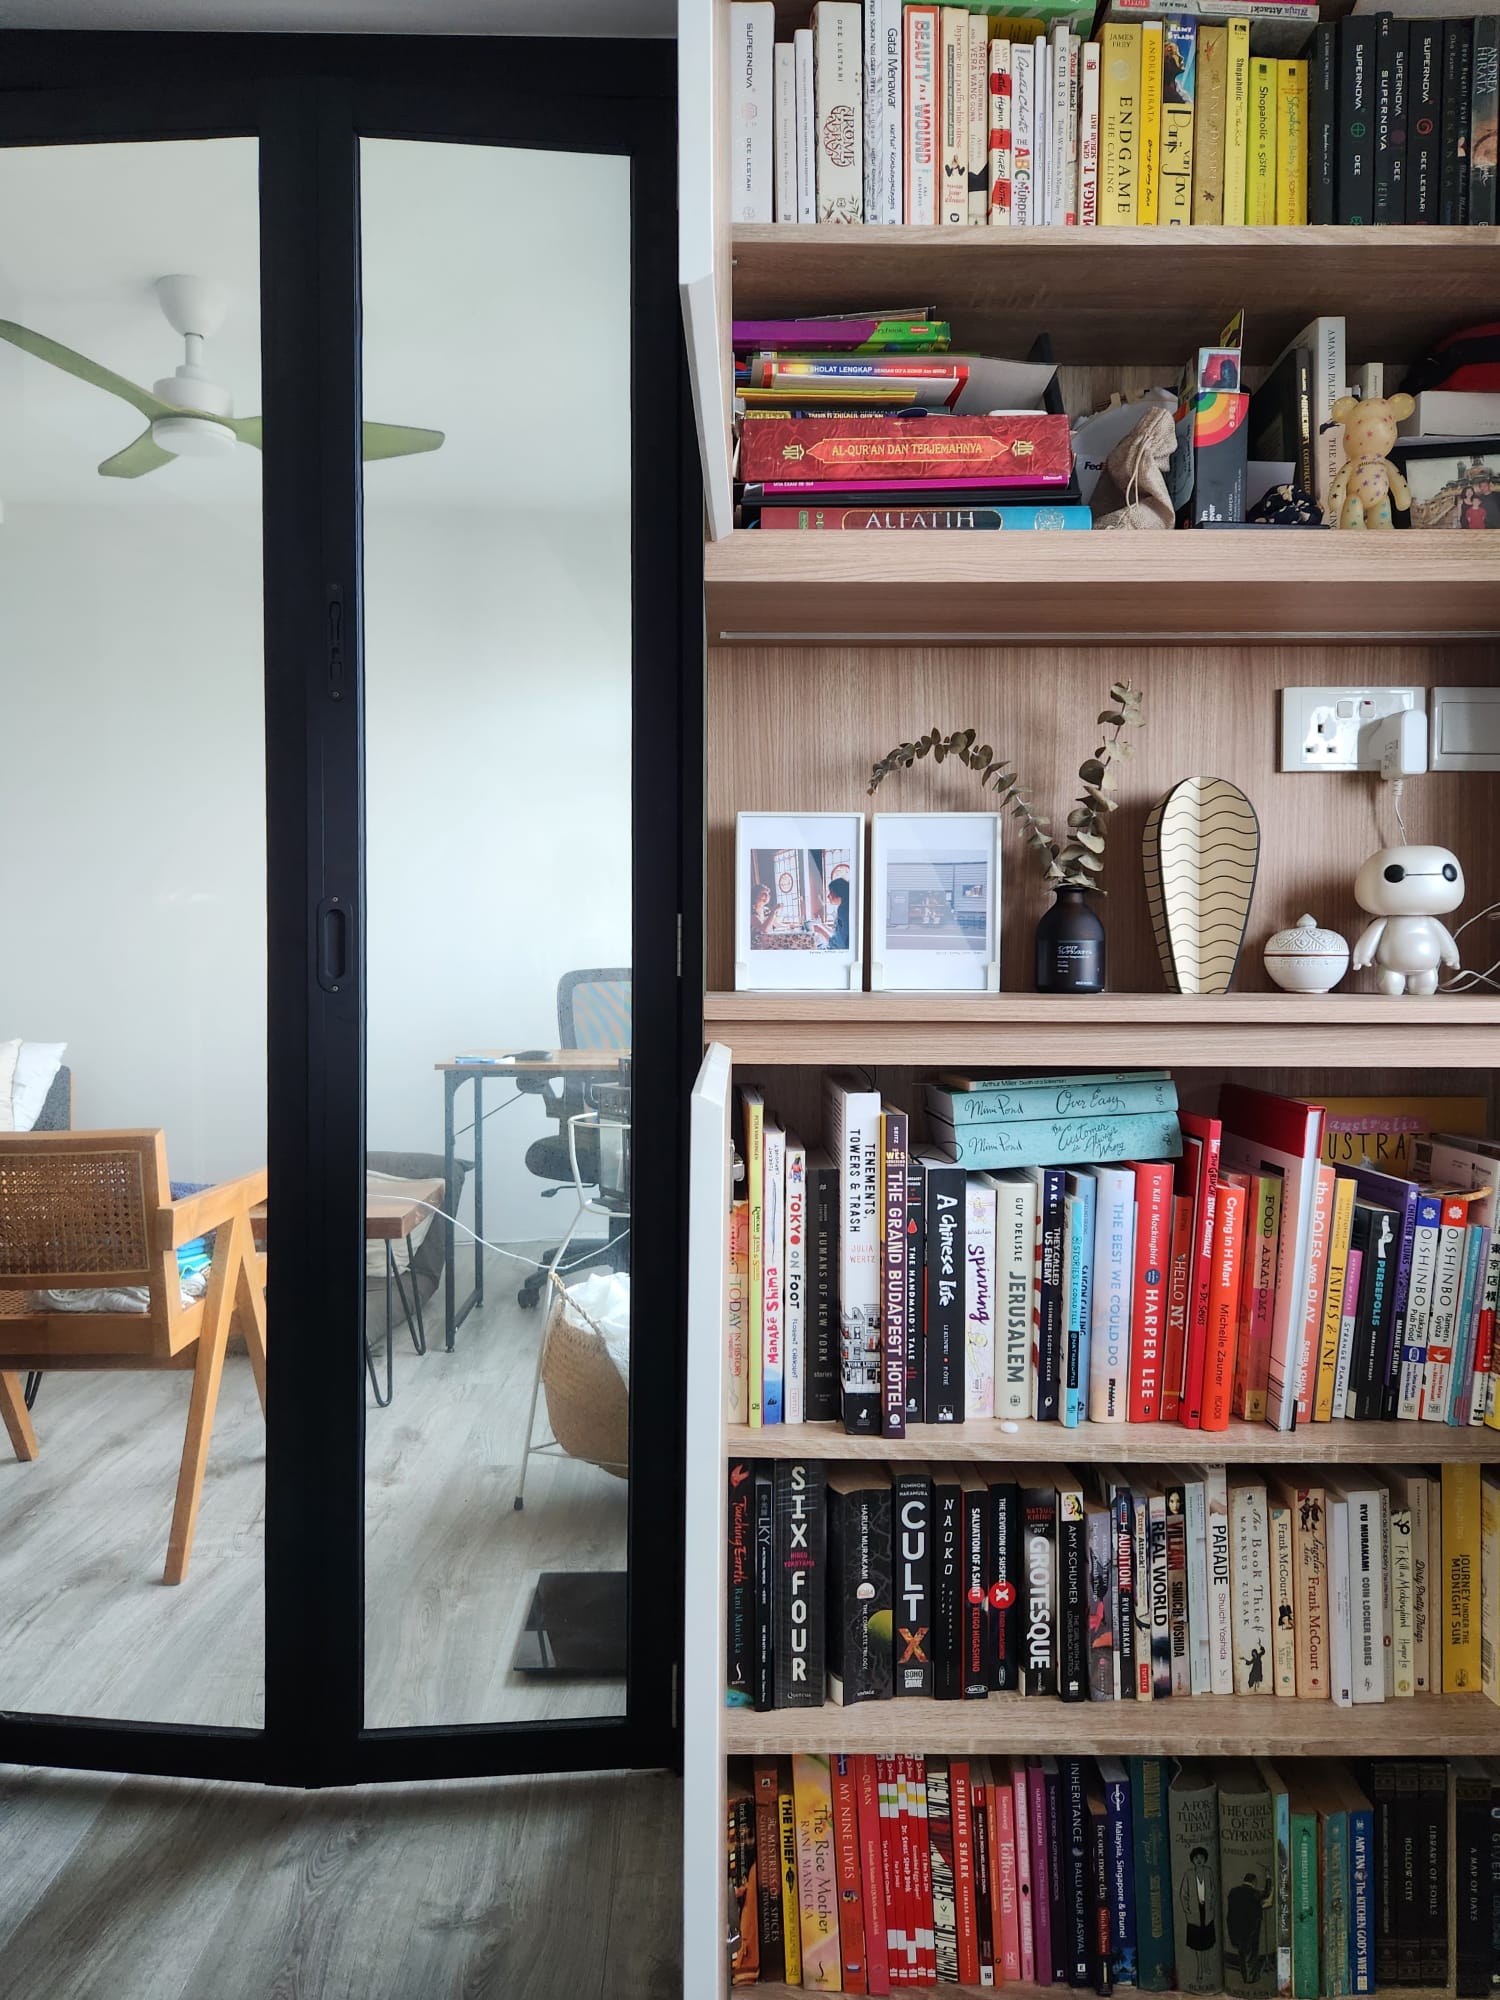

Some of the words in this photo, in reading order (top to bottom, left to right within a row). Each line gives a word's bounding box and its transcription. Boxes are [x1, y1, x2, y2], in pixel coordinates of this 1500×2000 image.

[888, 28, 897, 56] Gatal
[915, 20, 930, 81] BEAUTY
[888, 59, 897, 108] Menawar
[1058, 48, 1066, 107] semasa
[1395, 52, 1404, 116] SUPERNOVA
[1422, 38, 1431, 102] SUPERNOVA
[1477, 47, 1487, 94] HIRATA
[1487, 49, 1497, 93] ANDREA
[1380, 70, 1388, 150] SUPERNOVA
[915, 103, 931, 163] WOUND
[1118, 96, 1132, 212] ENDGAME
[832, 445, 884, 457] AL-QUR'AN
[887, 444, 908, 455] DAN
[911, 444, 982, 455] TERJEMAHNYA
[866, 511, 975, 529] ALFATIH
[850, 1129, 860, 1177] TOWERS
[864, 1144, 875, 1219] TENEMENTS,
[888, 1172, 902, 1201] THE
[1050, 1177, 1058, 1213] TAKEI
[1151, 1189, 1161, 1202] Kill
[1153, 1175, 1162, 1184] To
[790, 1194, 801, 1245] TOKYO
[850, 1195, 860, 1232] TRASH
[937, 1195, 958, 1210] A
[1014, 1198, 1023, 1218] GUY
[1113, 1202, 1123, 1231] THE
[1224, 1197, 1237, 1233] Crying
[1263, 1196, 1275, 1238] FOOD
[888, 1208, 902, 1263] GRAND
[940, 1215, 957, 1274] Chinese
[1014, 1224, 1023, 1262] DELISLE
[1045, 1232, 1052, 1243] US
[1053, 1227, 1061, 1247] THEY
[1112, 1235, 1122, 1264] BEST
[1148, 1214, 1160, 1264] Mockingbird
[1224, 1249, 1233, 1257] H
[1225, 1236, 1235, 1245] in
[790, 1251, 800, 1269] ON
[819, 1232, 827, 1277] HUMANS
[908, 1248, 916, 1265] THE
[1044, 1246, 1052, 1284] ENEMY
[790, 1274, 800, 1309] FOOT
[819, 1284, 827, 1297] OF
[968, 1244, 990, 1325] Spinning
[1111, 1271, 1121, 1289] WE
[1222, 1261, 1232, 1286] Mart
[1258, 1246, 1272, 1320] ANATOMY
[908, 1271, 916, 1333] HANDMAID'S
[939, 1280, 957, 1308] Life
[1373, 1260, 1386, 1325] PERSEPOLIS
[819, 1304, 827, 1326] NEW
[888, 1271, 903, 1355] BUDAPEST
[1007, 1272, 1025, 1382] JERUSALEM
[1109, 1296, 1120, 1341] COULD
[1144, 1289, 1158, 1359] HARPER
[1217, 1304, 1229, 1347] Michelle
[819, 1334, 827, 1362] YORK
[908, 1338, 916, 1360] TALE
[1108, 1346, 1119, 1366] DO
[888, 1361, 902, 1410] HOTEL
[1142, 1369, 1155, 1398] LEE
[1215, 1351, 1226, 1386] Zauner
[791, 1466, 807, 1548] SIX
[1360, 1504, 1368, 1521] RYU
[759, 1518, 769, 1544] LKY
[972, 1508, 980, 1552] SALVATION
[1069, 1525, 1077, 1549] AMY
[1152, 1522, 1166, 1563] REAL
[1168, 1522, 1183, 1570] VILLAIN
[1279, 1523, 1288, 1551] Frank
[1361, 1524, 1369, 1572] MURAKAMI
[901, 1500, 926, 1622] CULT
[972, 1554, 980, 1564] OF
[999, 1546, 1006, 1556] OF
[1118, 1534, 1131, 1585] AUDITION
[1213, 1525, 1227, 1585] PARADE
[972, 1573, 980, 1597] SAINT
[1069, 1552, 1077, 1604] SCHUMER
[1280, 1553, 1288, 1596] McCourt
[1362, 1577, 1370, 1597] COIN
[1415, 1559, 1425, 1582] Dirty
[1452, 1559, 1460, 1617] MIDNIGHT
[1460, 1554, 1470, 1601] JOURNEY
[996, 1588, 1008, 1601] X
[1026, 1536, 1050, 1669] GROTESQUE
[1154, 1566, 1166, 1626] WORLD
[1308, 1577, 1319, 1611] Frank
[1414, 1585, 1425, 1611] Pretty
[792, 1571, 806, 1681] FOUR
[1362, 1600, 1371, 1633] LOCKER
[1414, 1614, 1425, 1643] Things
[1452, 1622, 1460, 1644] SUN
[898, 1627, 929, 1663] X
[1122, 1616, 1130, 1657] MURAKAMI
[1309, 1616, 1320, 1670] McCourt
[839, 1783, 848, 1801] MY
[956, 1779, 967, 1834] SHINJUKU
[1070, 1763, 1082, 1842] INHERITANCE
[782, 1800, 792, 1823] THE
[813, 1805, 829, 1834] The
[841, 1807, 852, 1840] NINE
[783, 1827, 794, 1864] THIEF
[800, 1821, 810, 1851] RANI
[1097, 1825, 1105, 1838] for
[1114, 1821, 1123, 1858] Malaysia,
[1355, 1836, 1365, 1852] AMY
[815, 1840, 829, 1872] Rice
[843, 1845, 854, 1879] LIVES
[960, 1842, 968, 1879] SHARK
[1356, 1854, 1365, 1868] TAN
[1404, 1838, 1412, 1877] HOLLOW
[802, 1859, 814, 1920] MANICKA
[1098, 1884, 1107, 1900] day
[1115, 1860, 1124, 1901] Singapore
[1356, 1883, 1365, 1894] The
[1405, 1881, 1413, 1901] CITY
[817, 1878, 832, 1934] Mother
[1356, 1897, 1366, 1928] KITCHEN
[1357, 1930, 1366, 1955] GOD'S
[1357, 1957, 1367, 1975] WIFE
